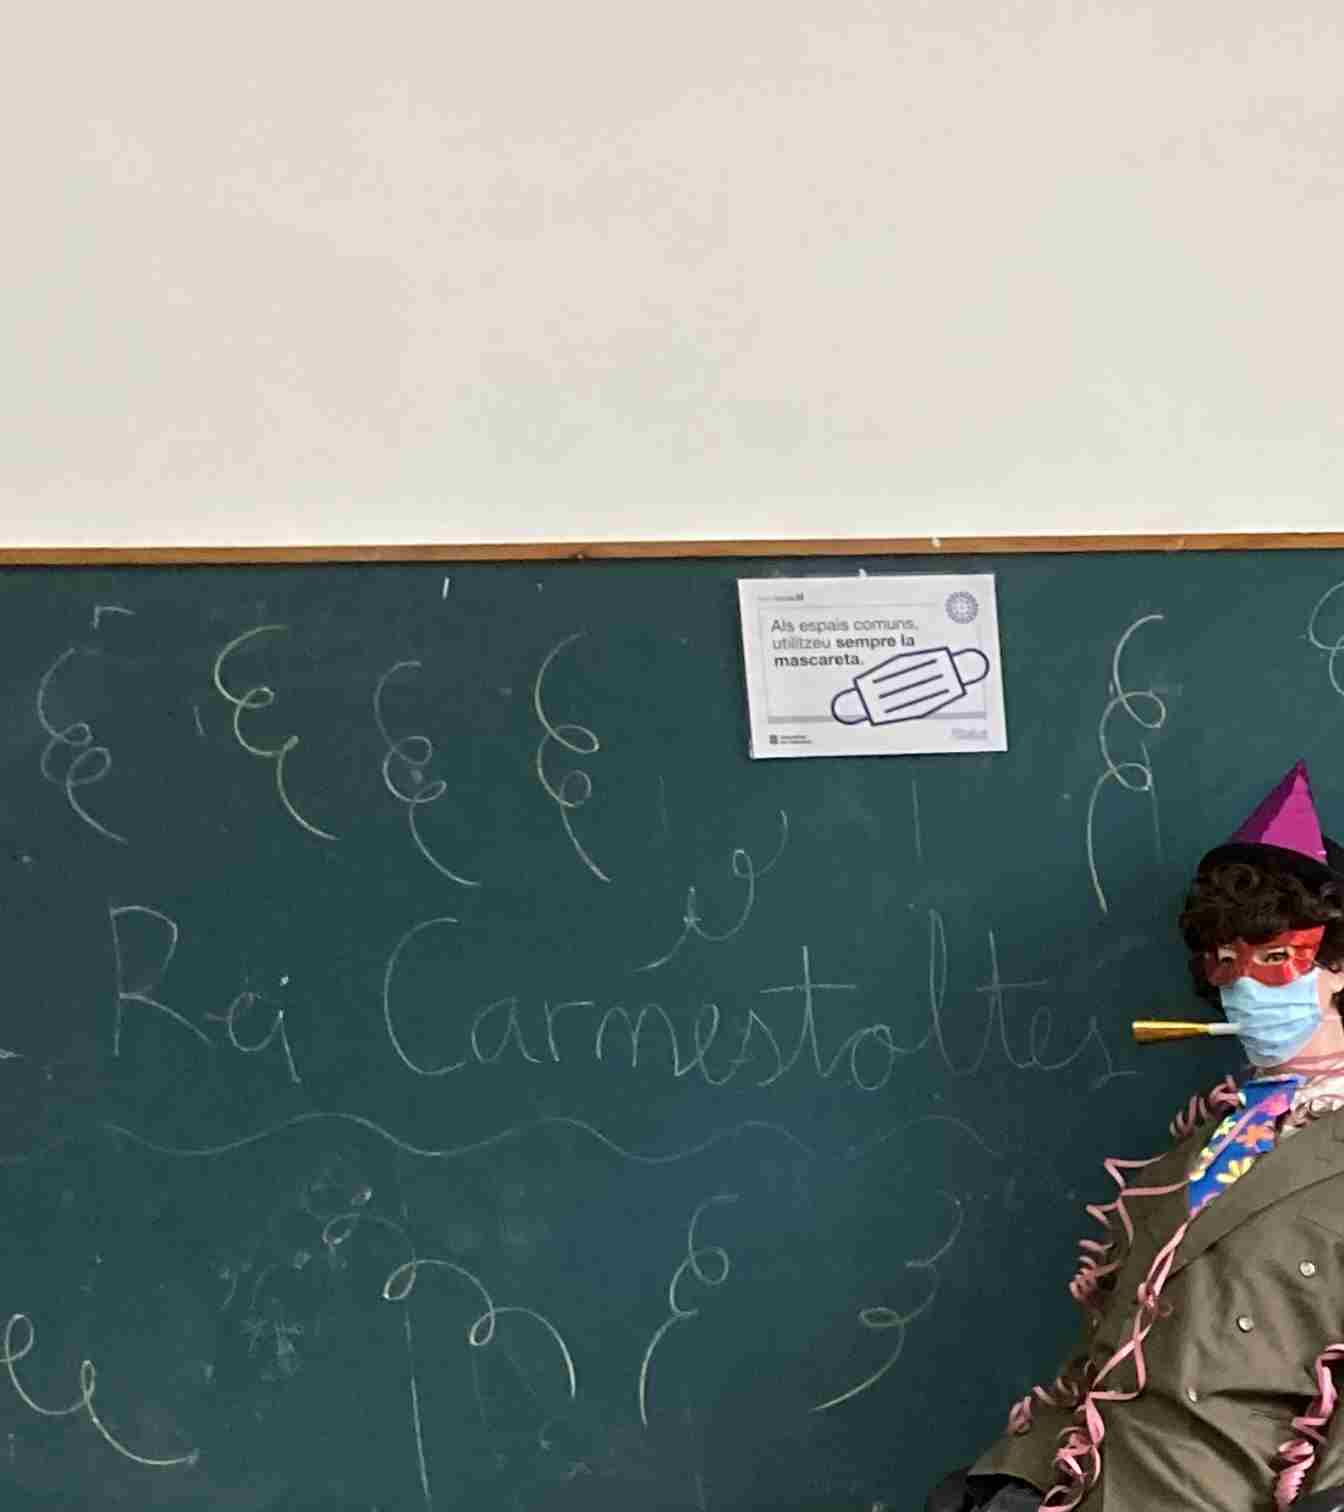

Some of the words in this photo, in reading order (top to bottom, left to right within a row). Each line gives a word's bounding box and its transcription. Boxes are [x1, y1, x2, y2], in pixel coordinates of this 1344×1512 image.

[771, 619, 795, 633] Als
[799, 618, 849, 634] espais
[772, 636, 831, 650] utilitzeu
[836, 636, 897, 650] sempre
[901, 633, 915, 647] la
[774, 653, 864, 668] mascareta.
